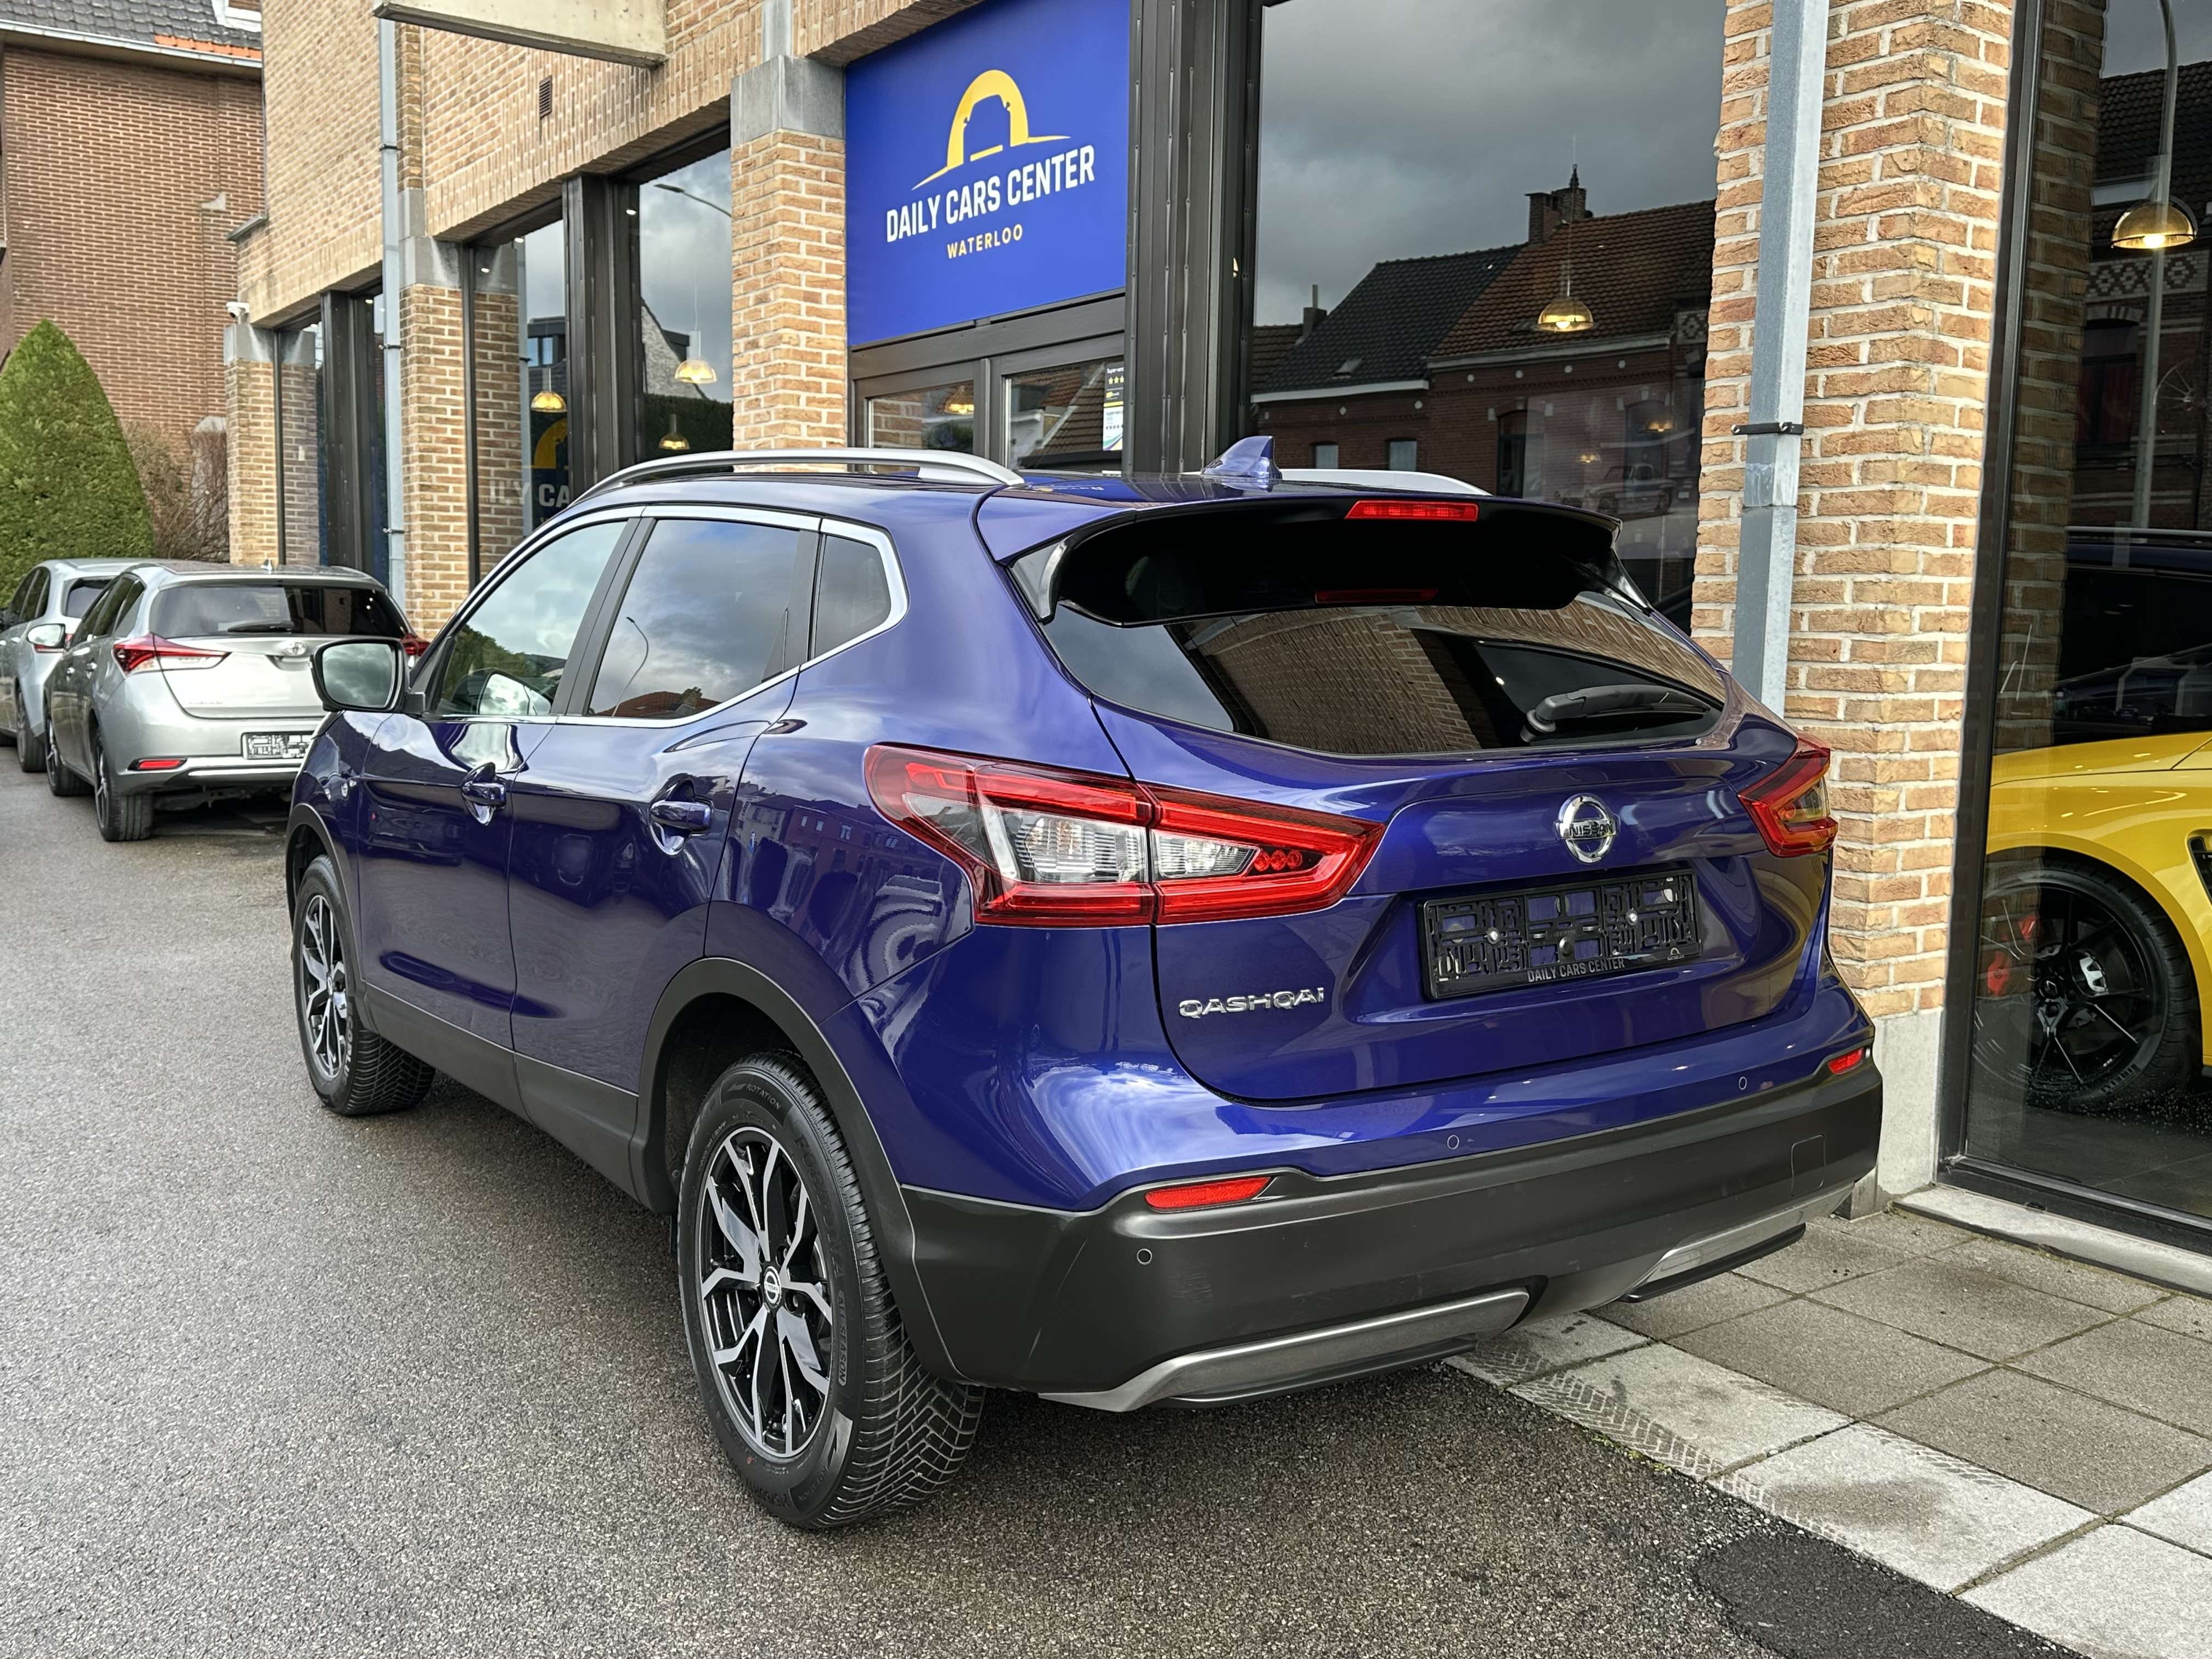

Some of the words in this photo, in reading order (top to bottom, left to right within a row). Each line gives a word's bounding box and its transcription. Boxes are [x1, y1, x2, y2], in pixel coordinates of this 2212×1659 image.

[887, 194, 940, 242] DAILY
[945, 176, 1001, 224] CARS
[1007, 144, 1095, 206] CENTER
[947, 224, 1023, 258] WATERLOO
[1570, 821, 1613, 837] NISSAN
[1527, 967, 1557, 983] DAILY
[1560, 962, 1587, 977] CARS
[1588, 958, 1626, 973] CENTER
[1179, 987, 1324, 1019] QASHQAI
[746, 1084, 781, 1110] ROTATION
